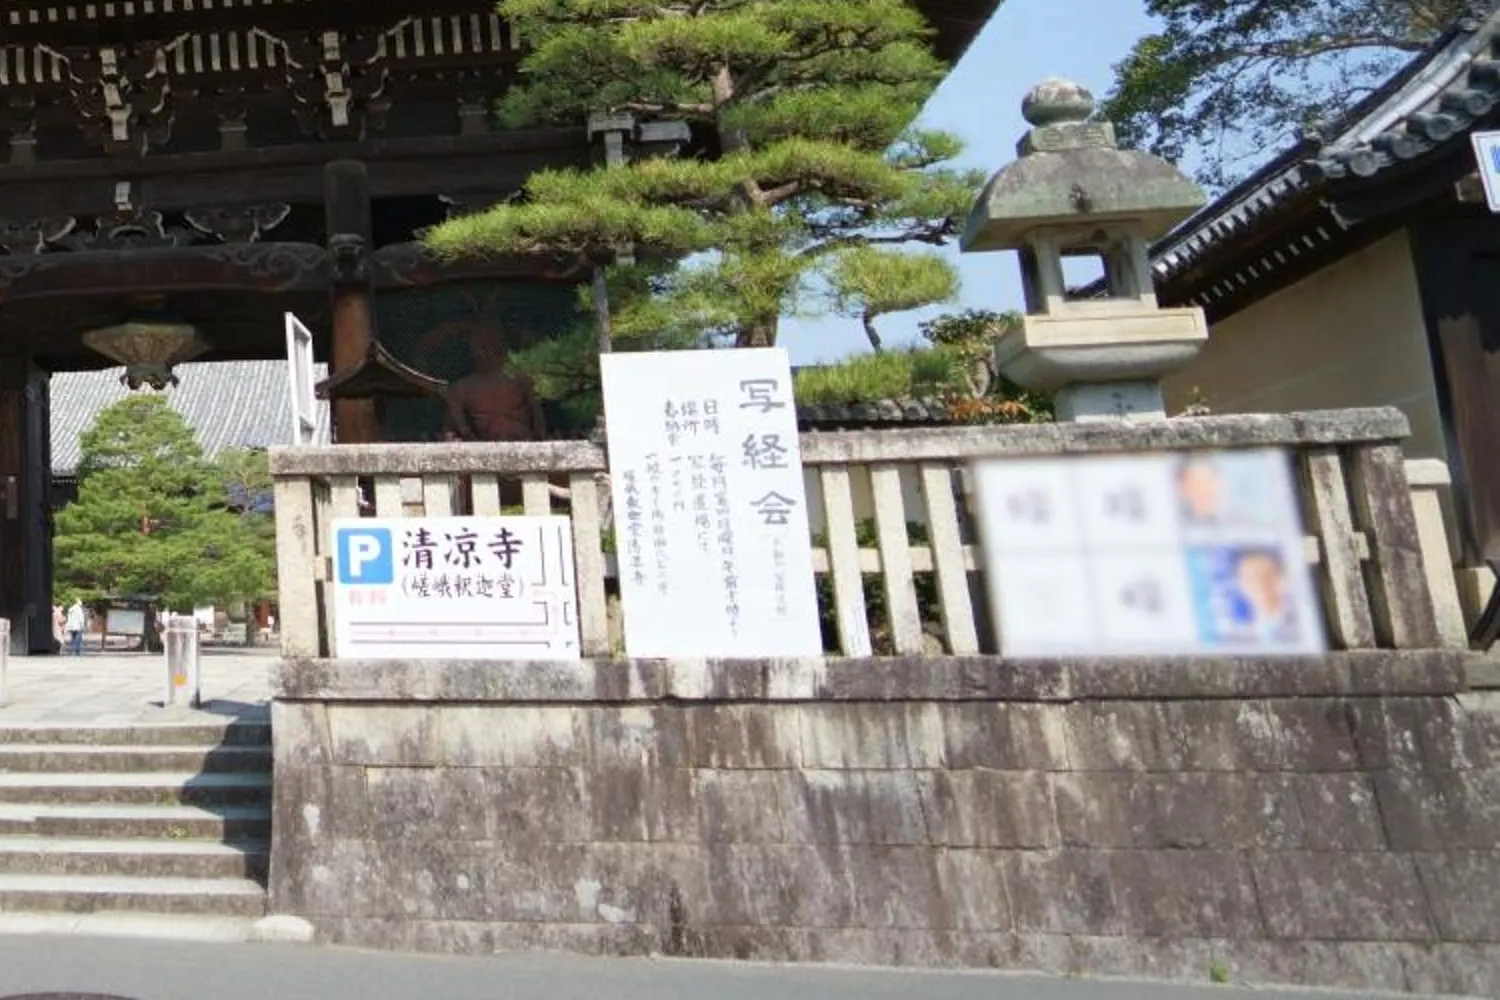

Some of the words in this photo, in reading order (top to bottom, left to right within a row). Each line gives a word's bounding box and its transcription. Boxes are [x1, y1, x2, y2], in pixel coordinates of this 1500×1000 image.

[739, 378, 797, 525] 写経会
[349, 534, 382, 577] P
